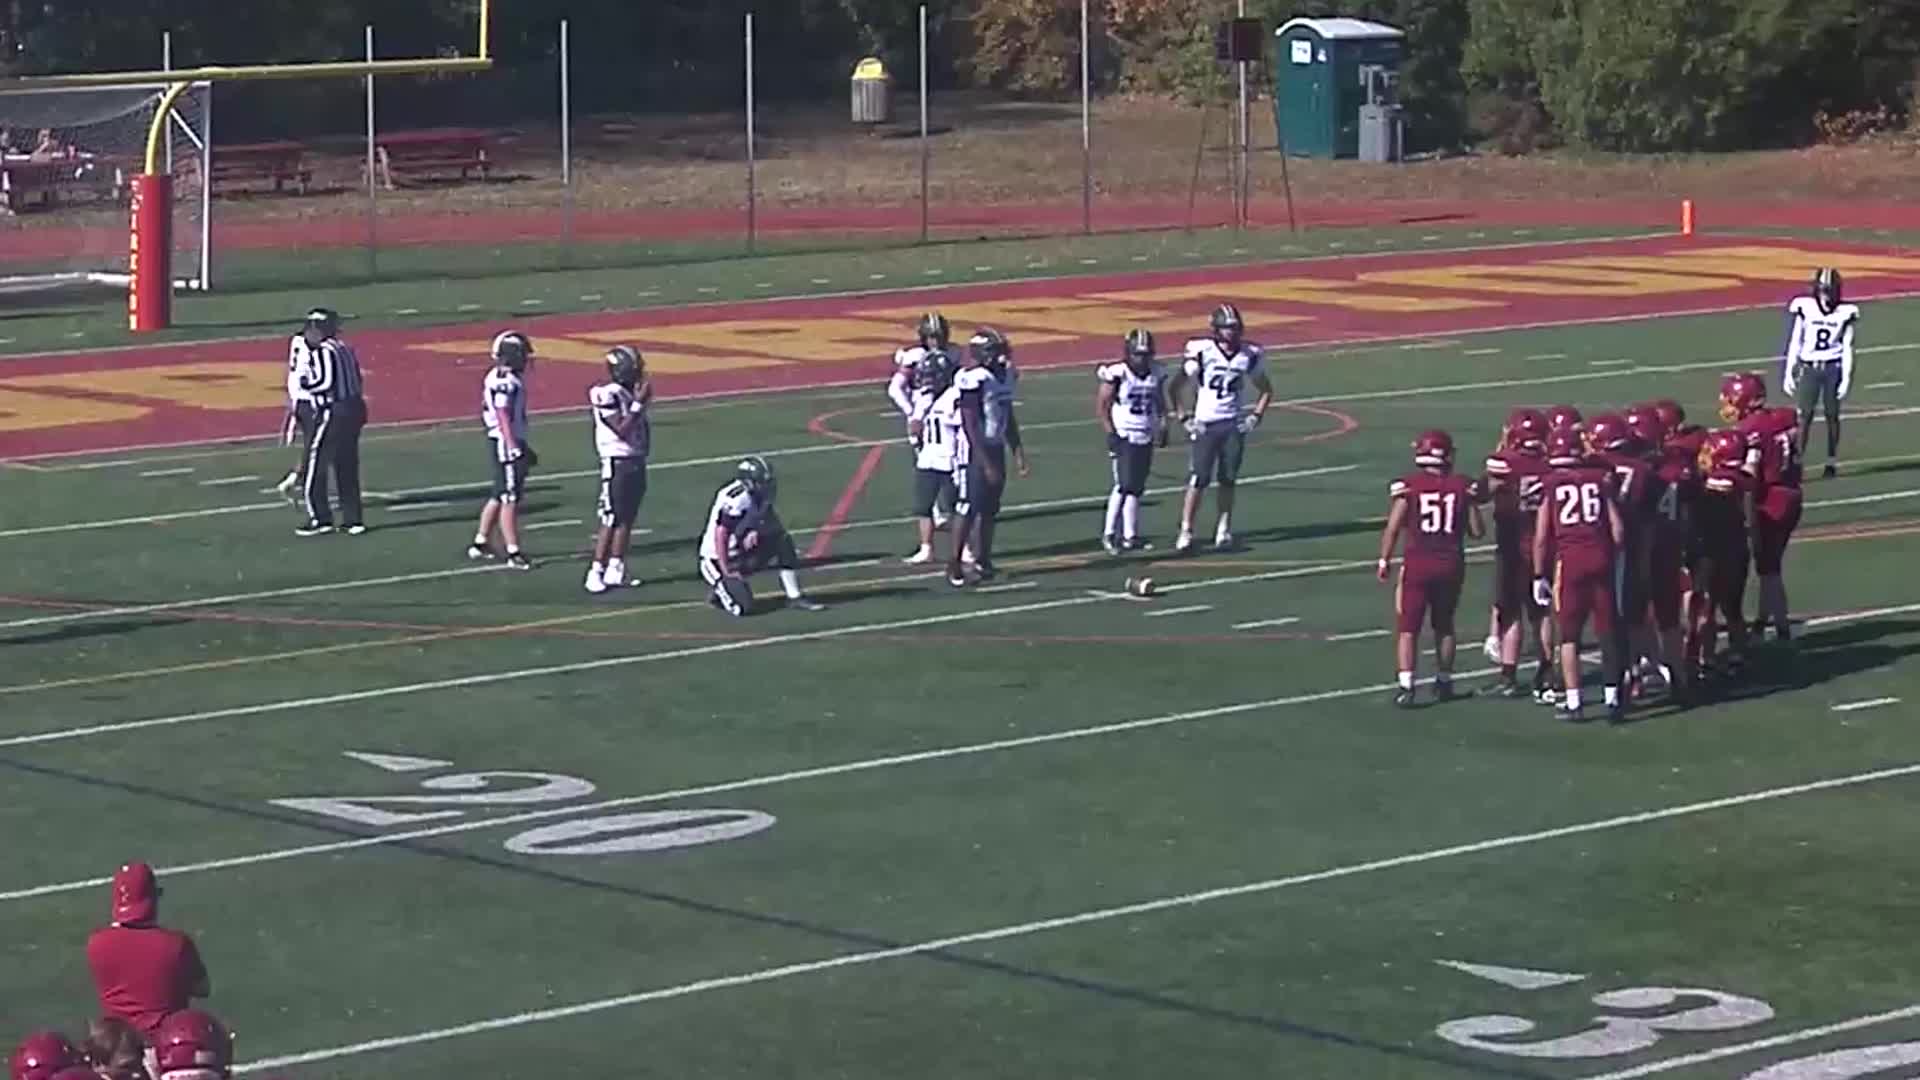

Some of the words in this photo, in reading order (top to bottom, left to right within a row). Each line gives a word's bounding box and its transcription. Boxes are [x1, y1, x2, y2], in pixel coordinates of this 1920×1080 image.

[1815, 328, 1831, 351] 8
[927, 417, 942, 445] 11
[1419, 492, 1456, 534] 51
[1555, 482, 1600, 525] 26
[268, 771, 777, 855] 20
